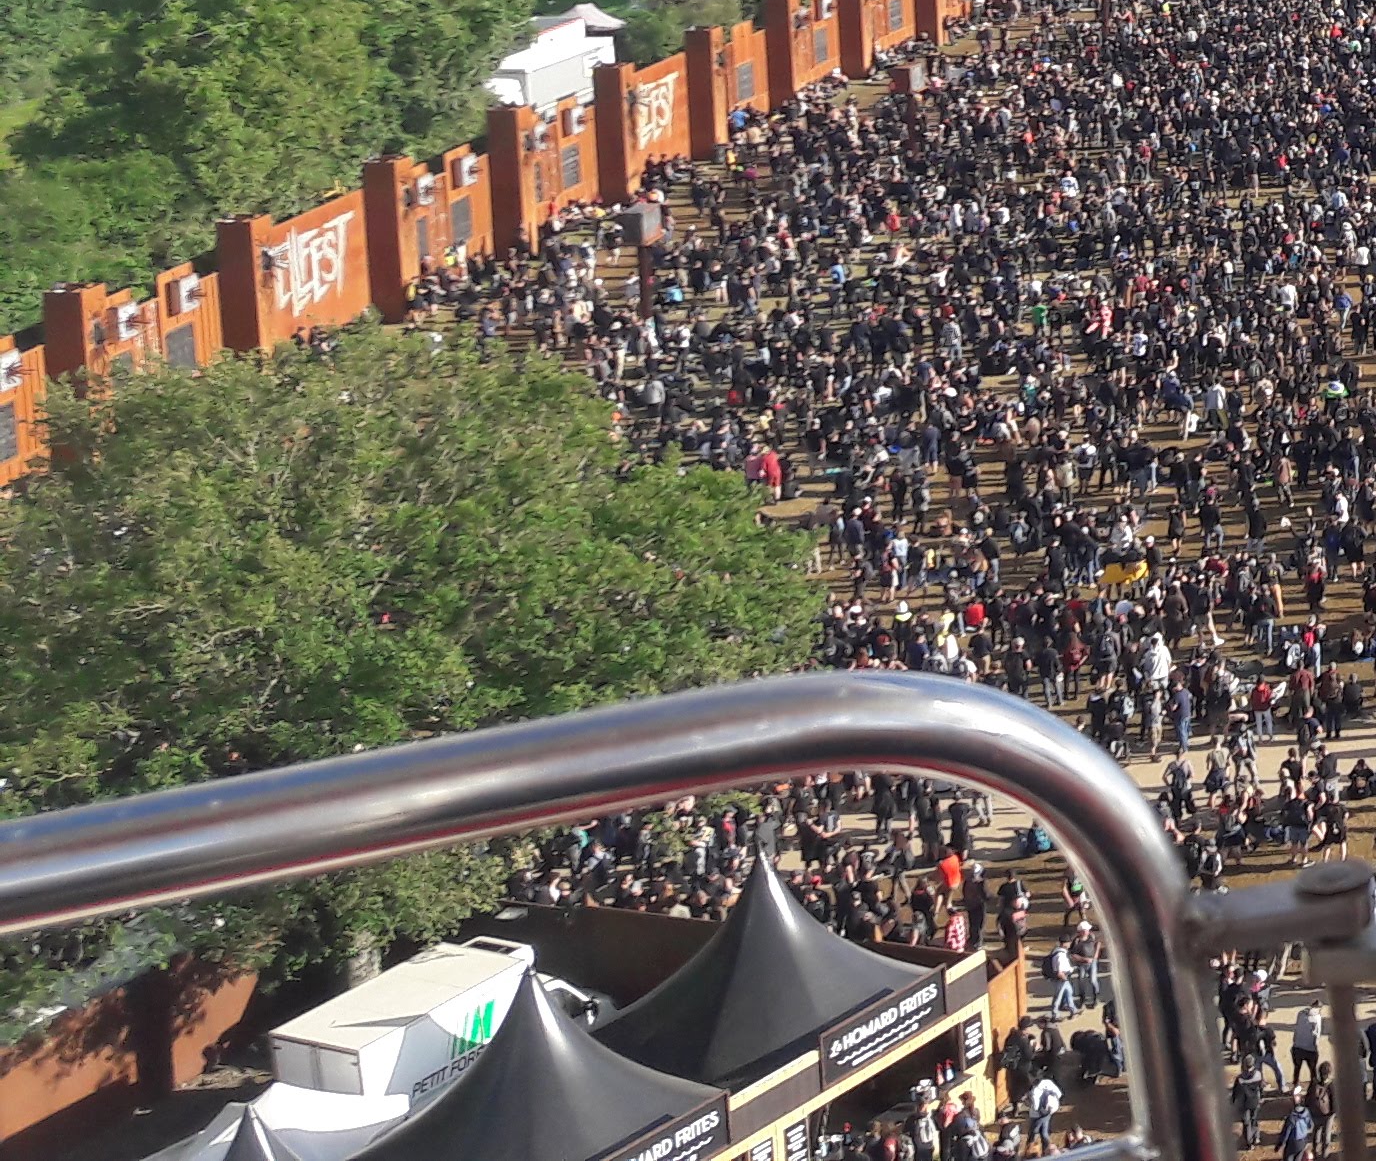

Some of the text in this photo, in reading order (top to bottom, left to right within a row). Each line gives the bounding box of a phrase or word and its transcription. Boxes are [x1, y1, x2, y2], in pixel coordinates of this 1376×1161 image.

[842, 1007, 899, 1051] HOMARD
[899, 984, 939, 1017] FRITES
[411, 1065, 449, 1099] PETIT
[675, 1110, 720, 1147] FRITES
